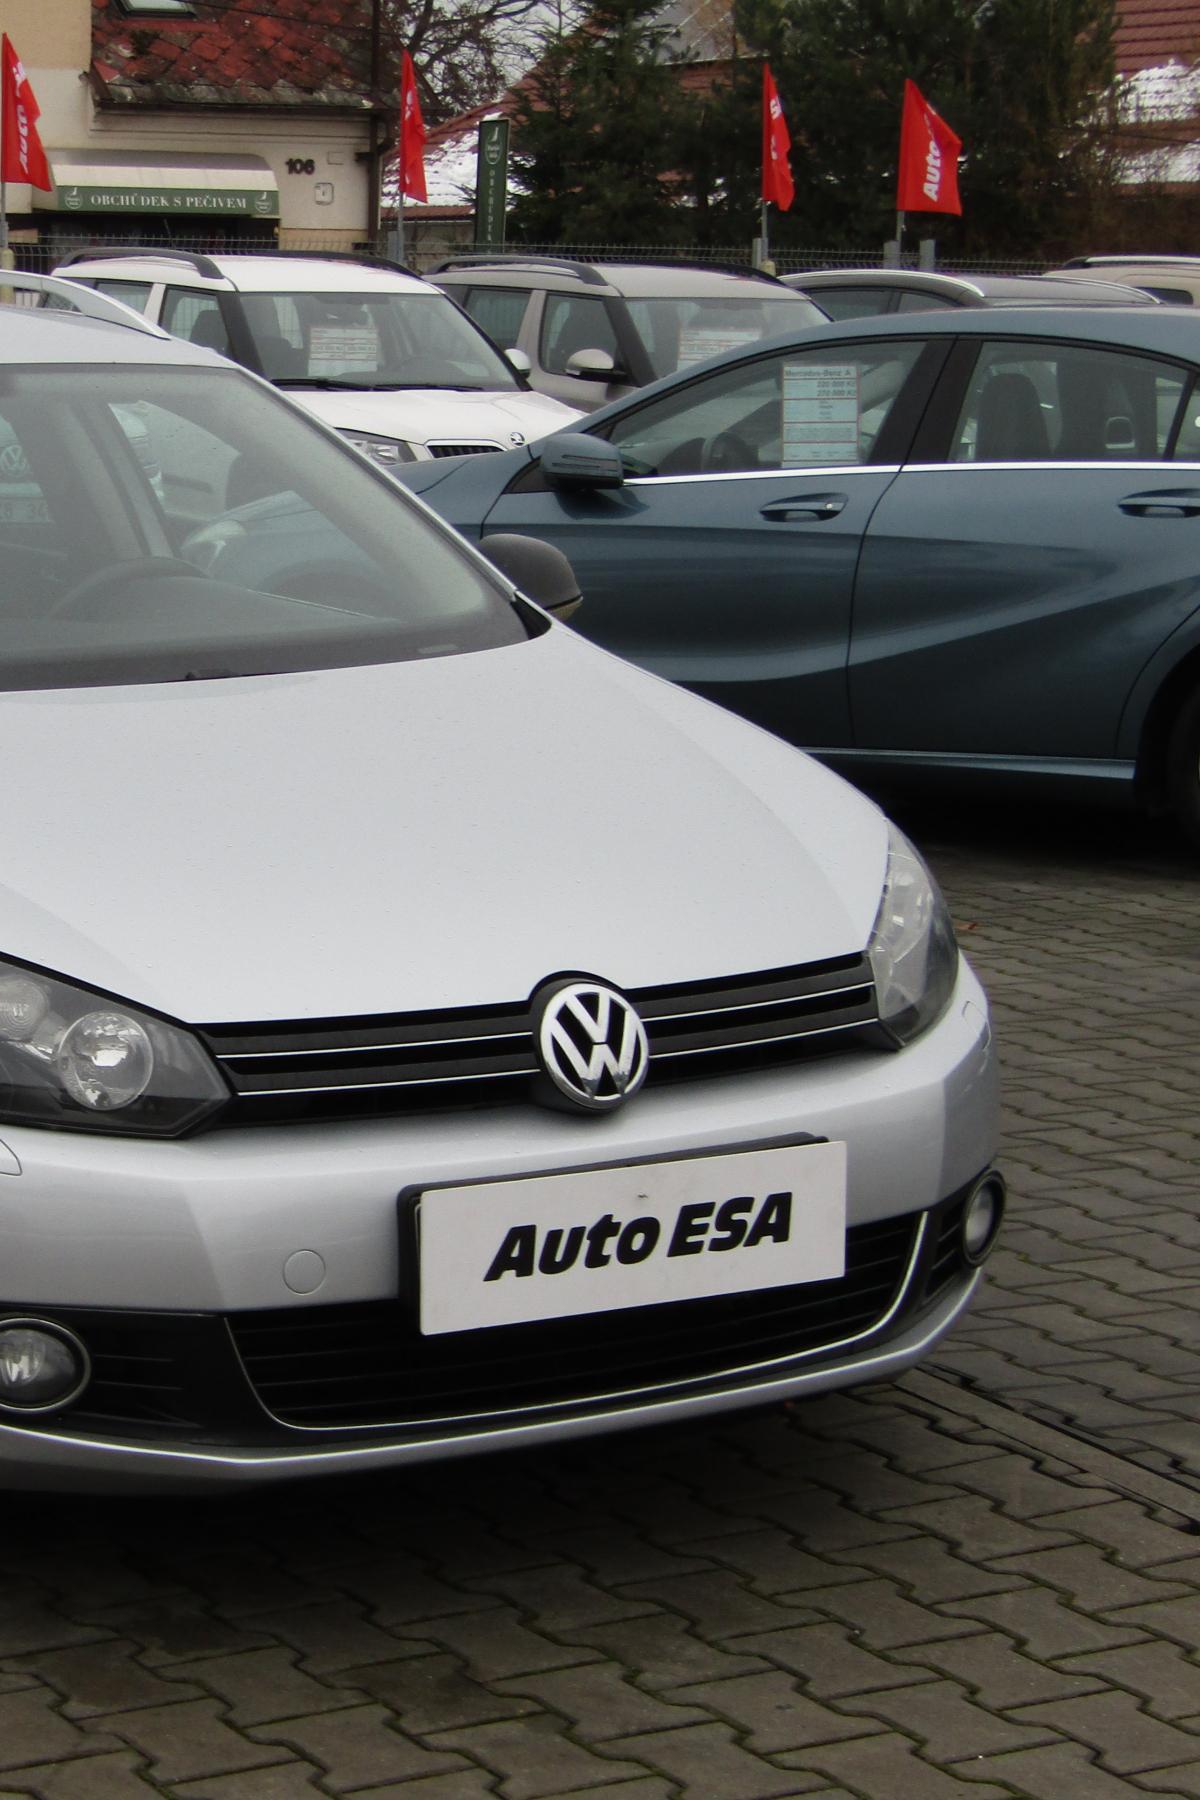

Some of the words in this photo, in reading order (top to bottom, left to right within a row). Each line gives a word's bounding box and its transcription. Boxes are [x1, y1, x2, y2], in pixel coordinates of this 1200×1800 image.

[90, 192, 170, 208] OBCHŮDEK
[173, 195, 182, 207] S
[186, 195, 247, 209] PEČIVEM
[482, 1213, 661, 1283] Auto
[666, 1191, 794, 1259] ESA
